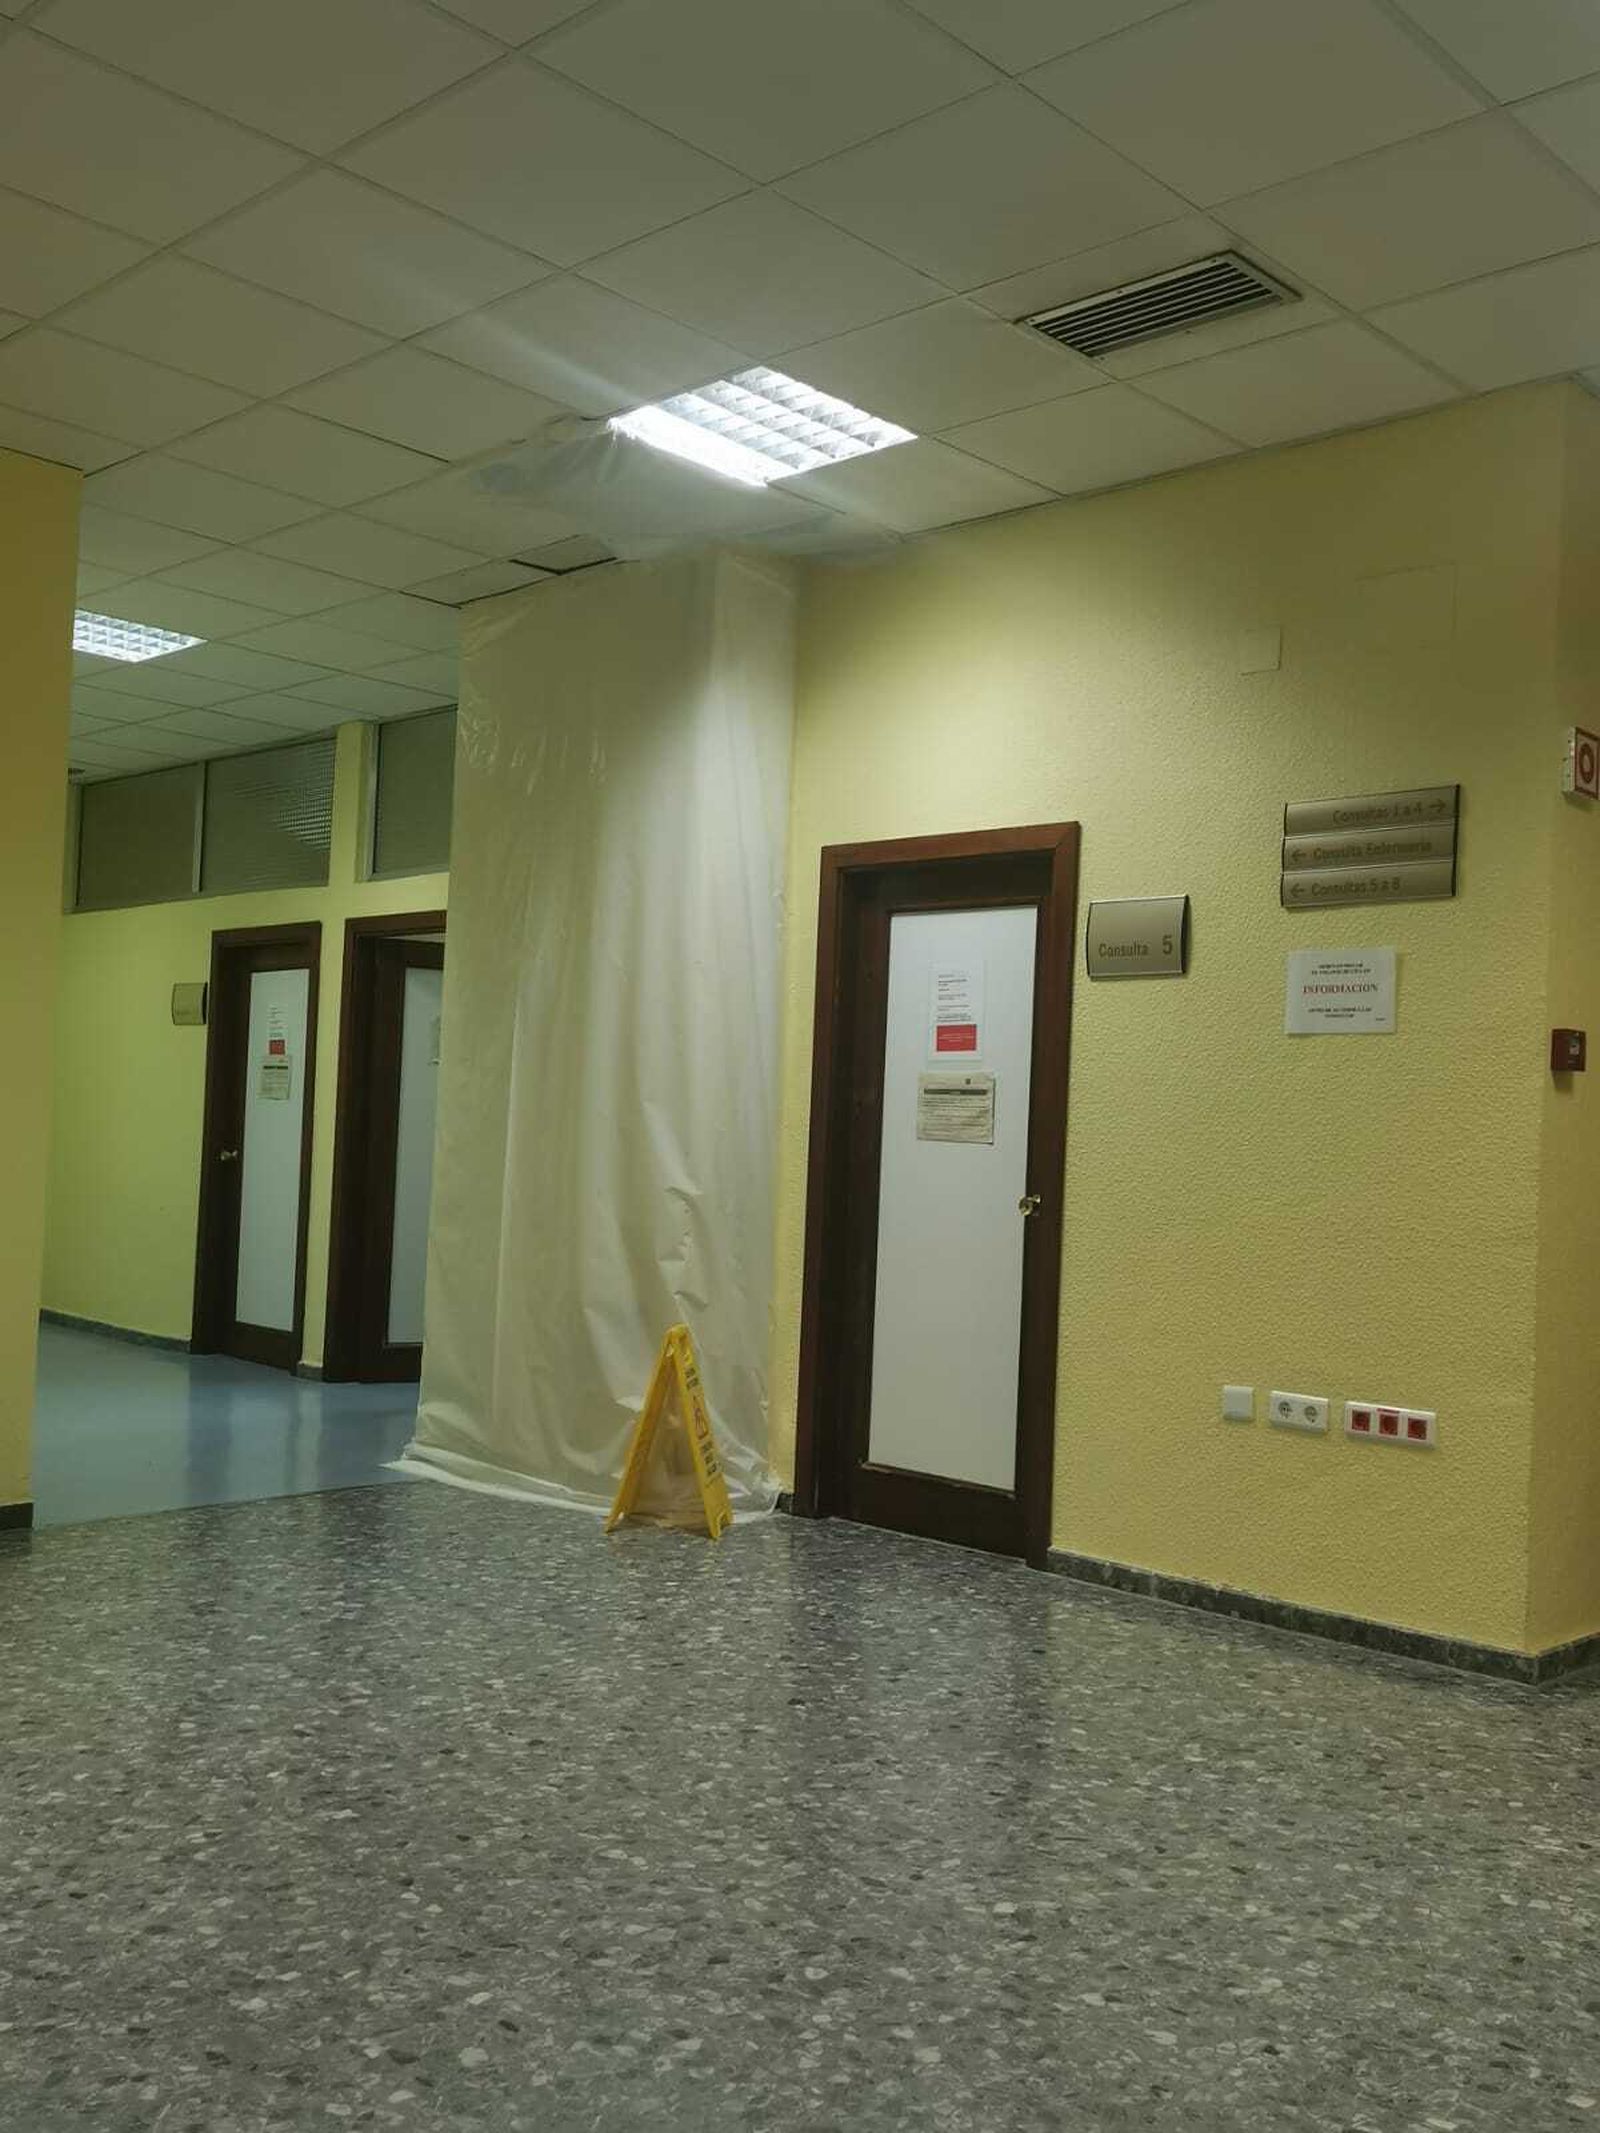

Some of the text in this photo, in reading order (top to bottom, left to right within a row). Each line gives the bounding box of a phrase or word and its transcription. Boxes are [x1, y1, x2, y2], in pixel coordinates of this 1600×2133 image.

[1311, 880, 1366, 895] Consultas
[1098, 935, 1173, 958] Consulta 5
